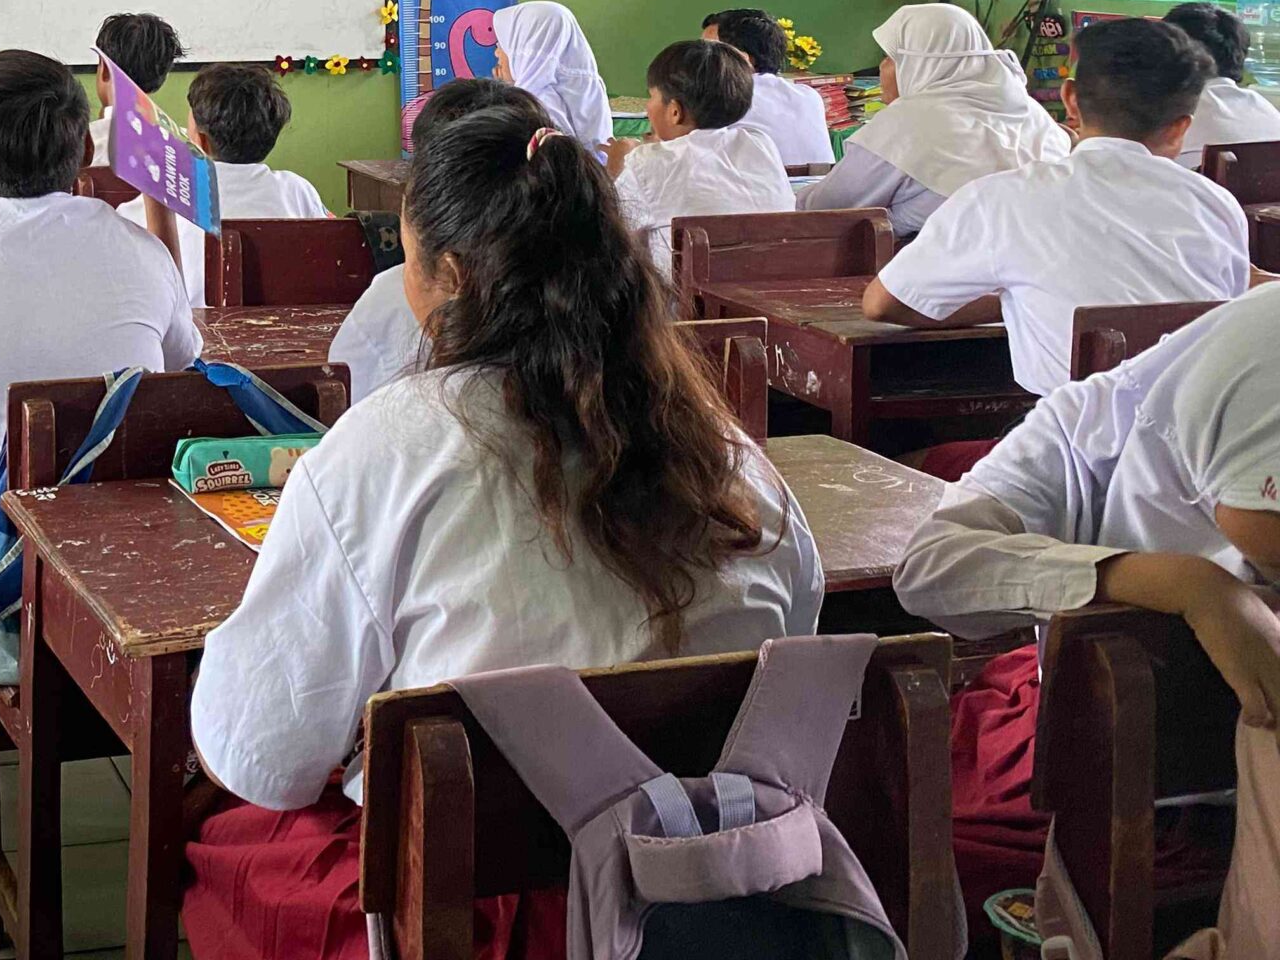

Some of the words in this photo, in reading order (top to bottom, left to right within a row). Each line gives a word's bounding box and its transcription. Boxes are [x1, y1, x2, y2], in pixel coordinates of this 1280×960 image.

[165, 145, 177, 198] DRAWING
[178, 173, 191, 206] BOOK
[196, 474, 250, 492] SQUIRREL
